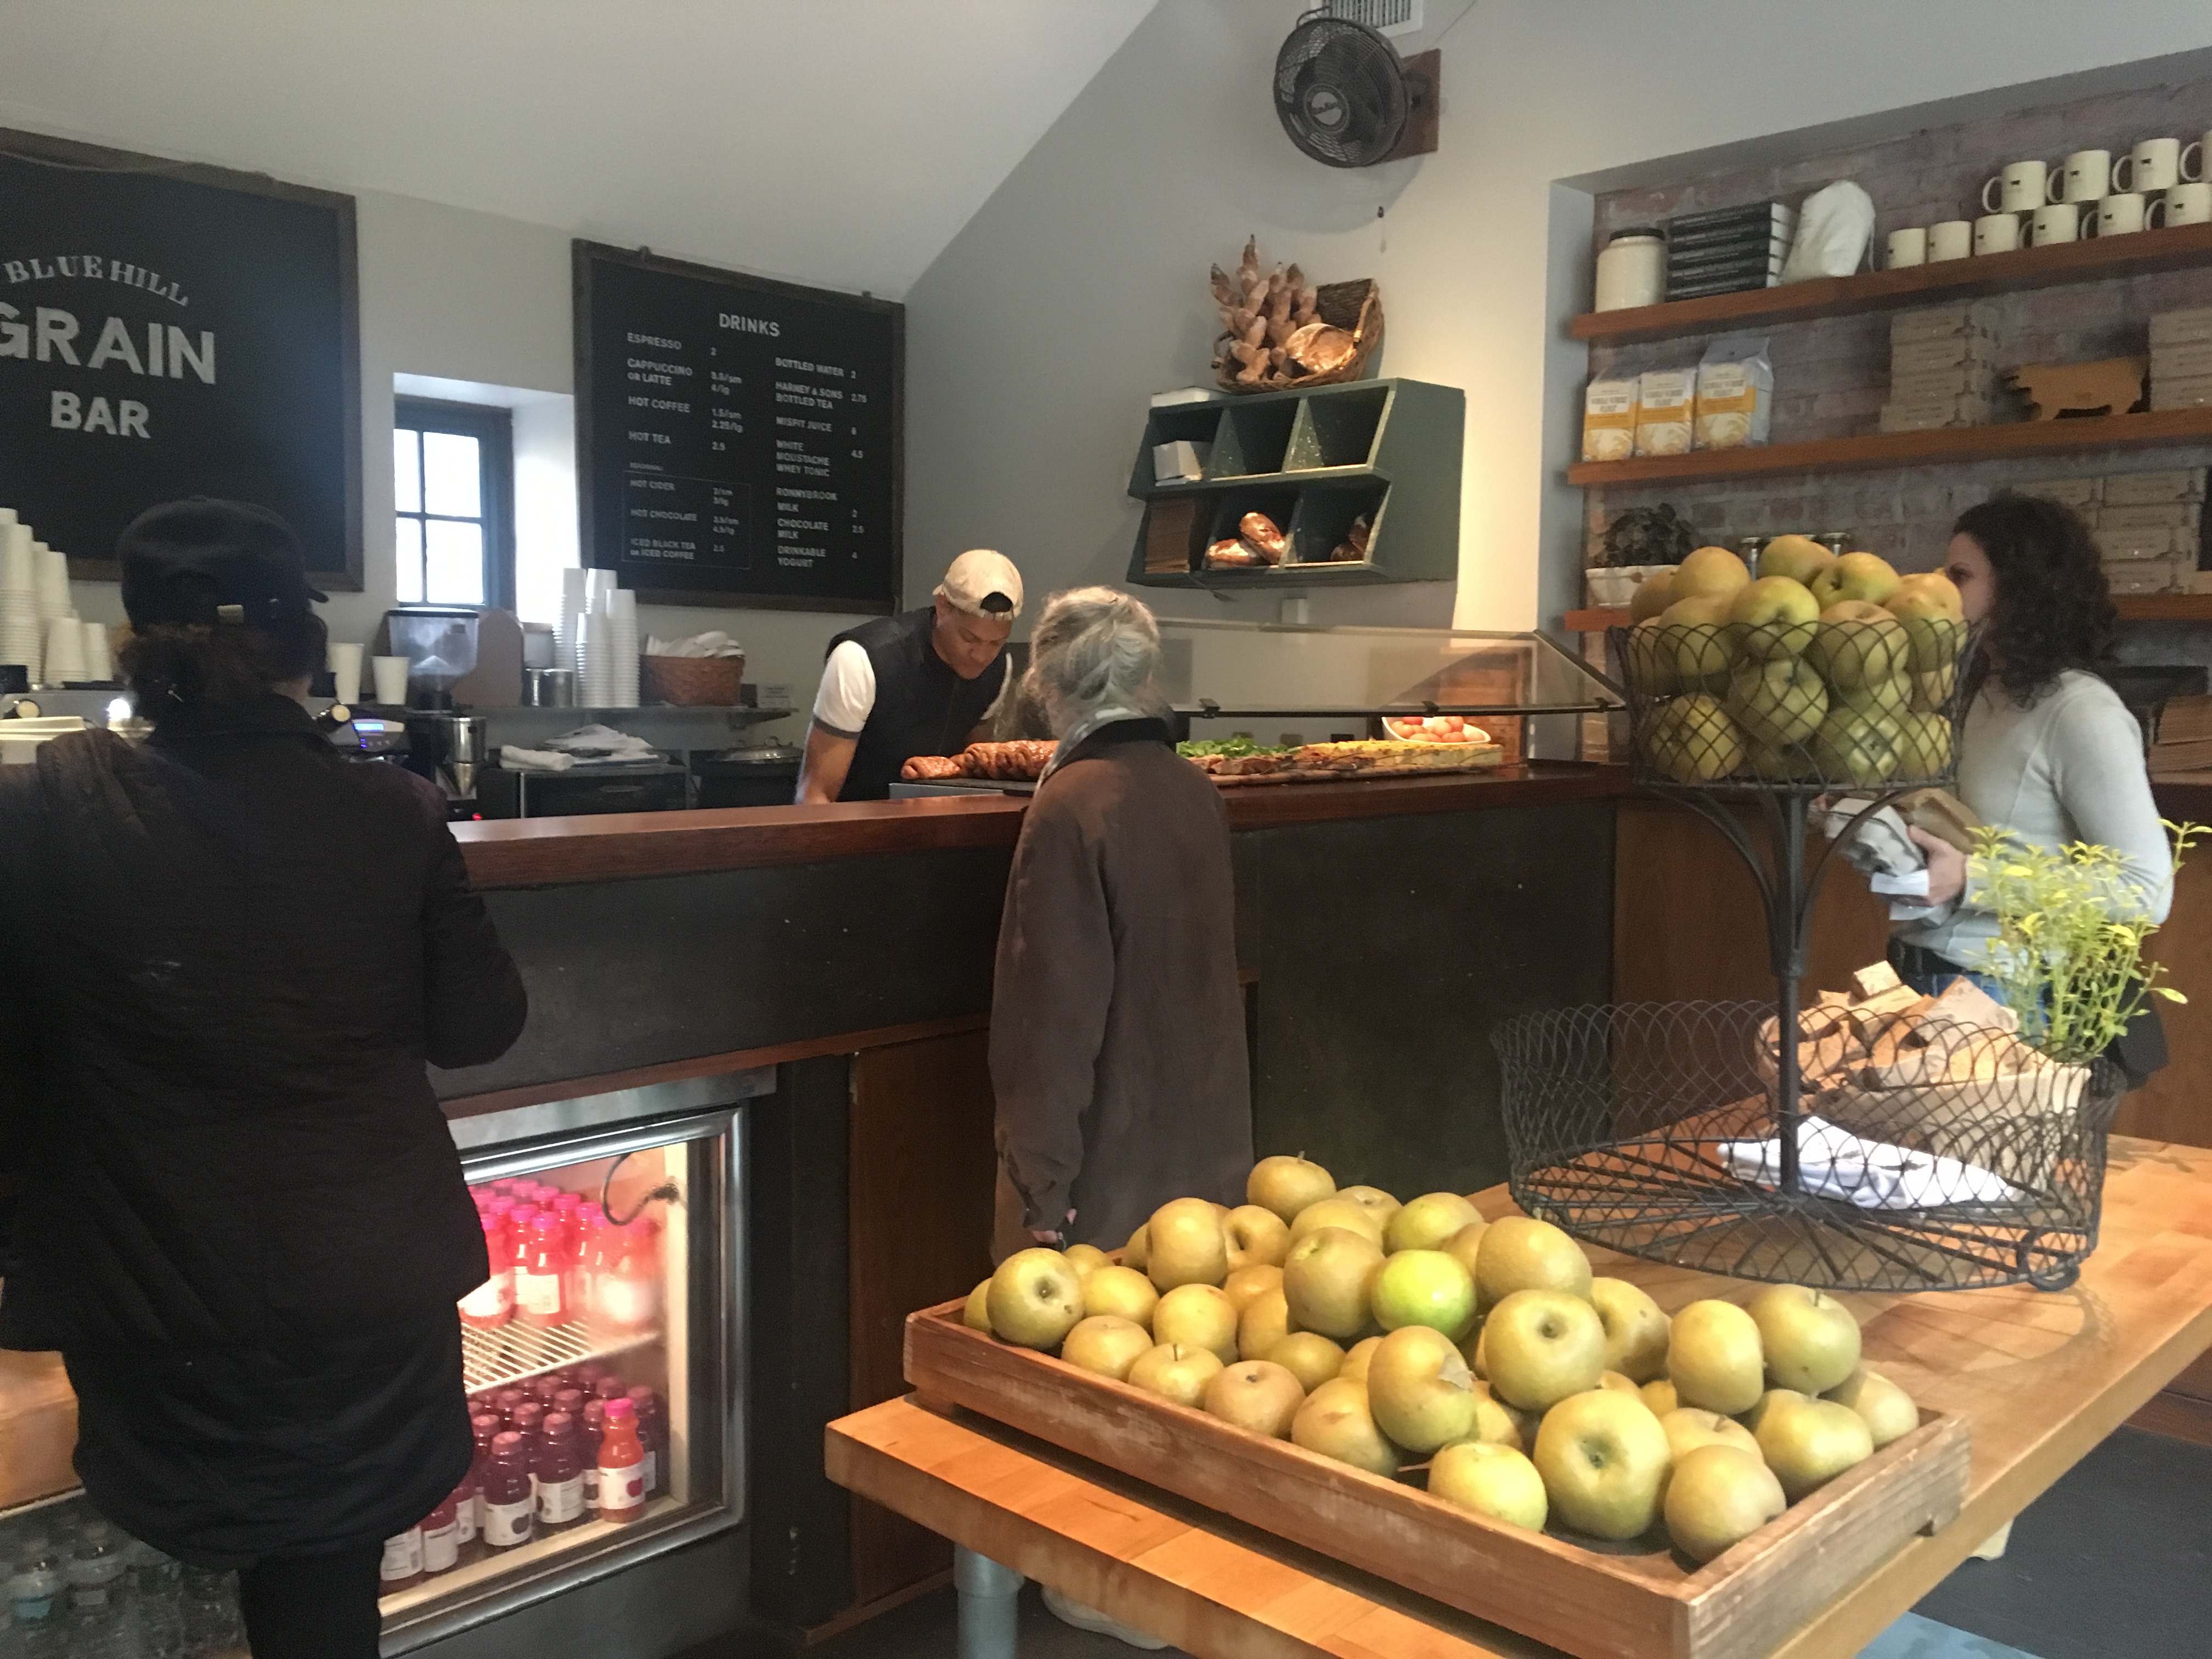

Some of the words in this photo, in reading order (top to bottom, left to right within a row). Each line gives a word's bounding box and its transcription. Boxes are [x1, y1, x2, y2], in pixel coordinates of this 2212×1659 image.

[3, 256, 103, 283] BLUE
[110, 261, 188, 306] HILL
[719, 312, 780, 338] DRINKS
[627, 332, 681, 349] ESPRESSO
[627, 358, 692, 376] CAPPUCCINO
[775, 357, 814, 371] BOTTLED
[816, 364, 844, 377] WATER
[642, 374, 672, 385] LATTE
[819, 388, 843, 399] SONS
[628, 396, 650, 407] HOT
[651, 399, 690, 413] COFFEE
[775, 392, 815, 407] BOTTLED
[817, 399, 833, 409] TEA
[50, 391, 151, 438] BAR
[776, 416, 805, 428] MISFIT
[807, 421, 832, 432] JUICE
[629, 431, 649, 441] HOT
[652, 433, 671, 444] TEA
[776, 439, 804, 452] WHITE
[630, 479, 647, 488] HOT
[777, 502, 799, 512] MILK
[649, 510, 697, 521] CHOCOLATE
[777, 518, 828, 531] CHOCOLATE
[777, 530, 799, 539] MILK
[662, 550, 694, 559] COFFEE
[777, 557, 814, 567] YOGURT
